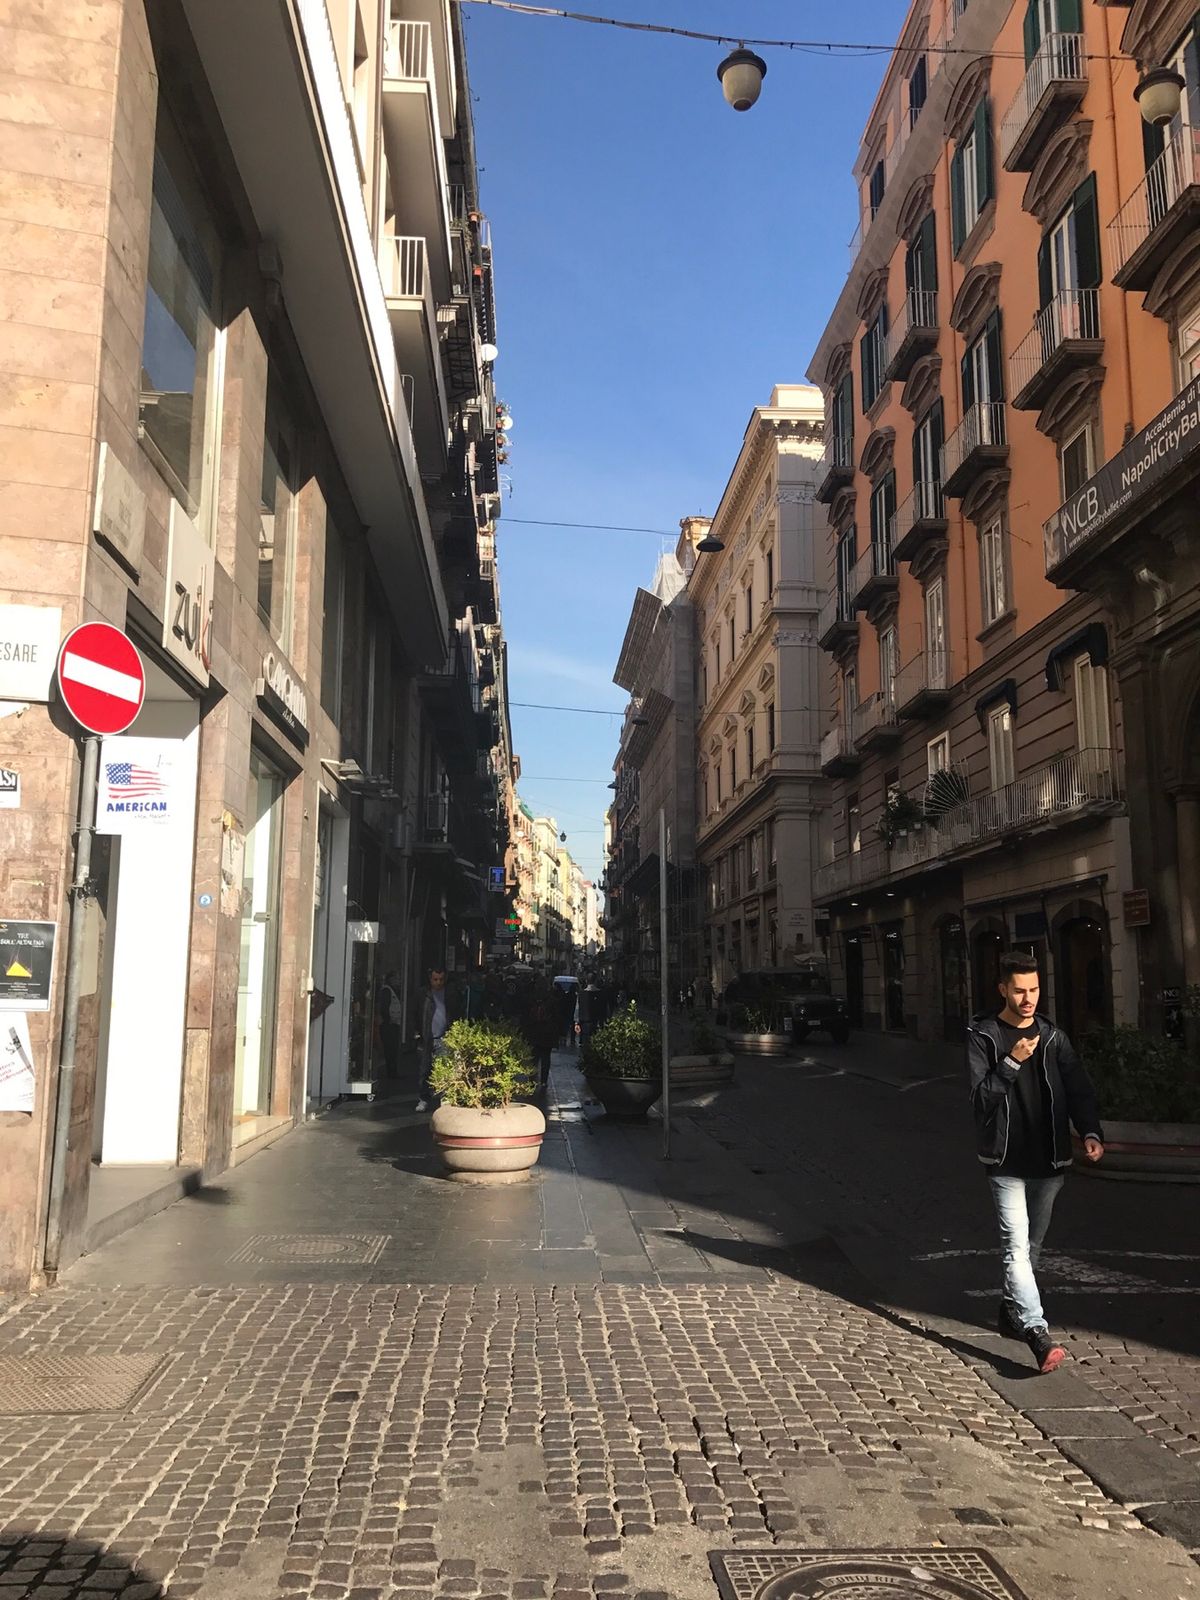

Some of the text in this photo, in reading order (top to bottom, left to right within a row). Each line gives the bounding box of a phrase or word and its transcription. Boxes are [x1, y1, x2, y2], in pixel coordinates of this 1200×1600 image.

[1145, 399, 1186, 445] Accademia
[1187, 387, 1196, 405] di
[1062, 486, 1099, 536] NCB
